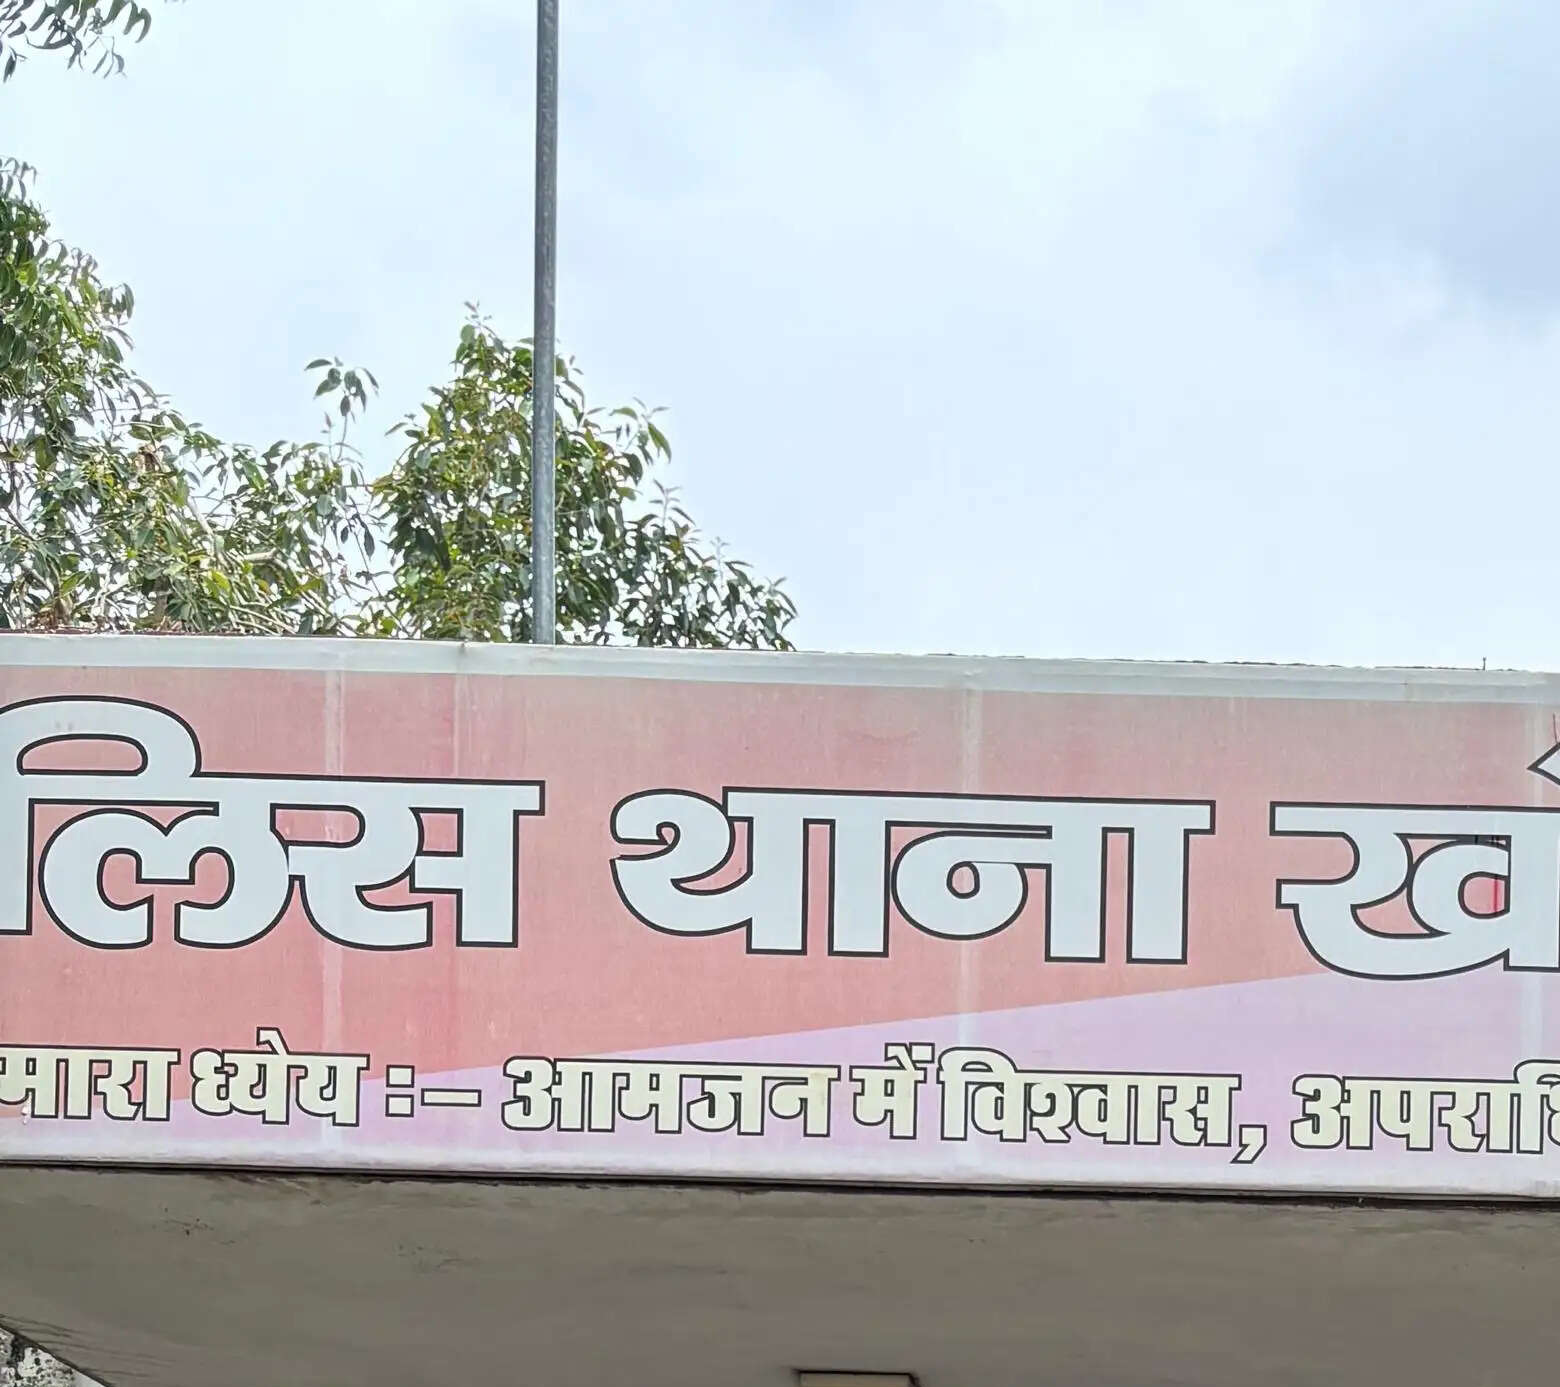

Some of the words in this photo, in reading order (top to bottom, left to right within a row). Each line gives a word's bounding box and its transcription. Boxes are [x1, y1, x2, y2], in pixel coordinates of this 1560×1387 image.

[0, 695, 546, 949] लिस
[610, 786, 1216, 963] थाना
[0, 1043, 182, 1122] मारा
[189, 1026, 371, 1126] ध्येय
[501, 1054, 839, 1139] आमजन
[852, 1041, 936, 1142] में
[938, 1046, 1268, 1164] विश्वास,
